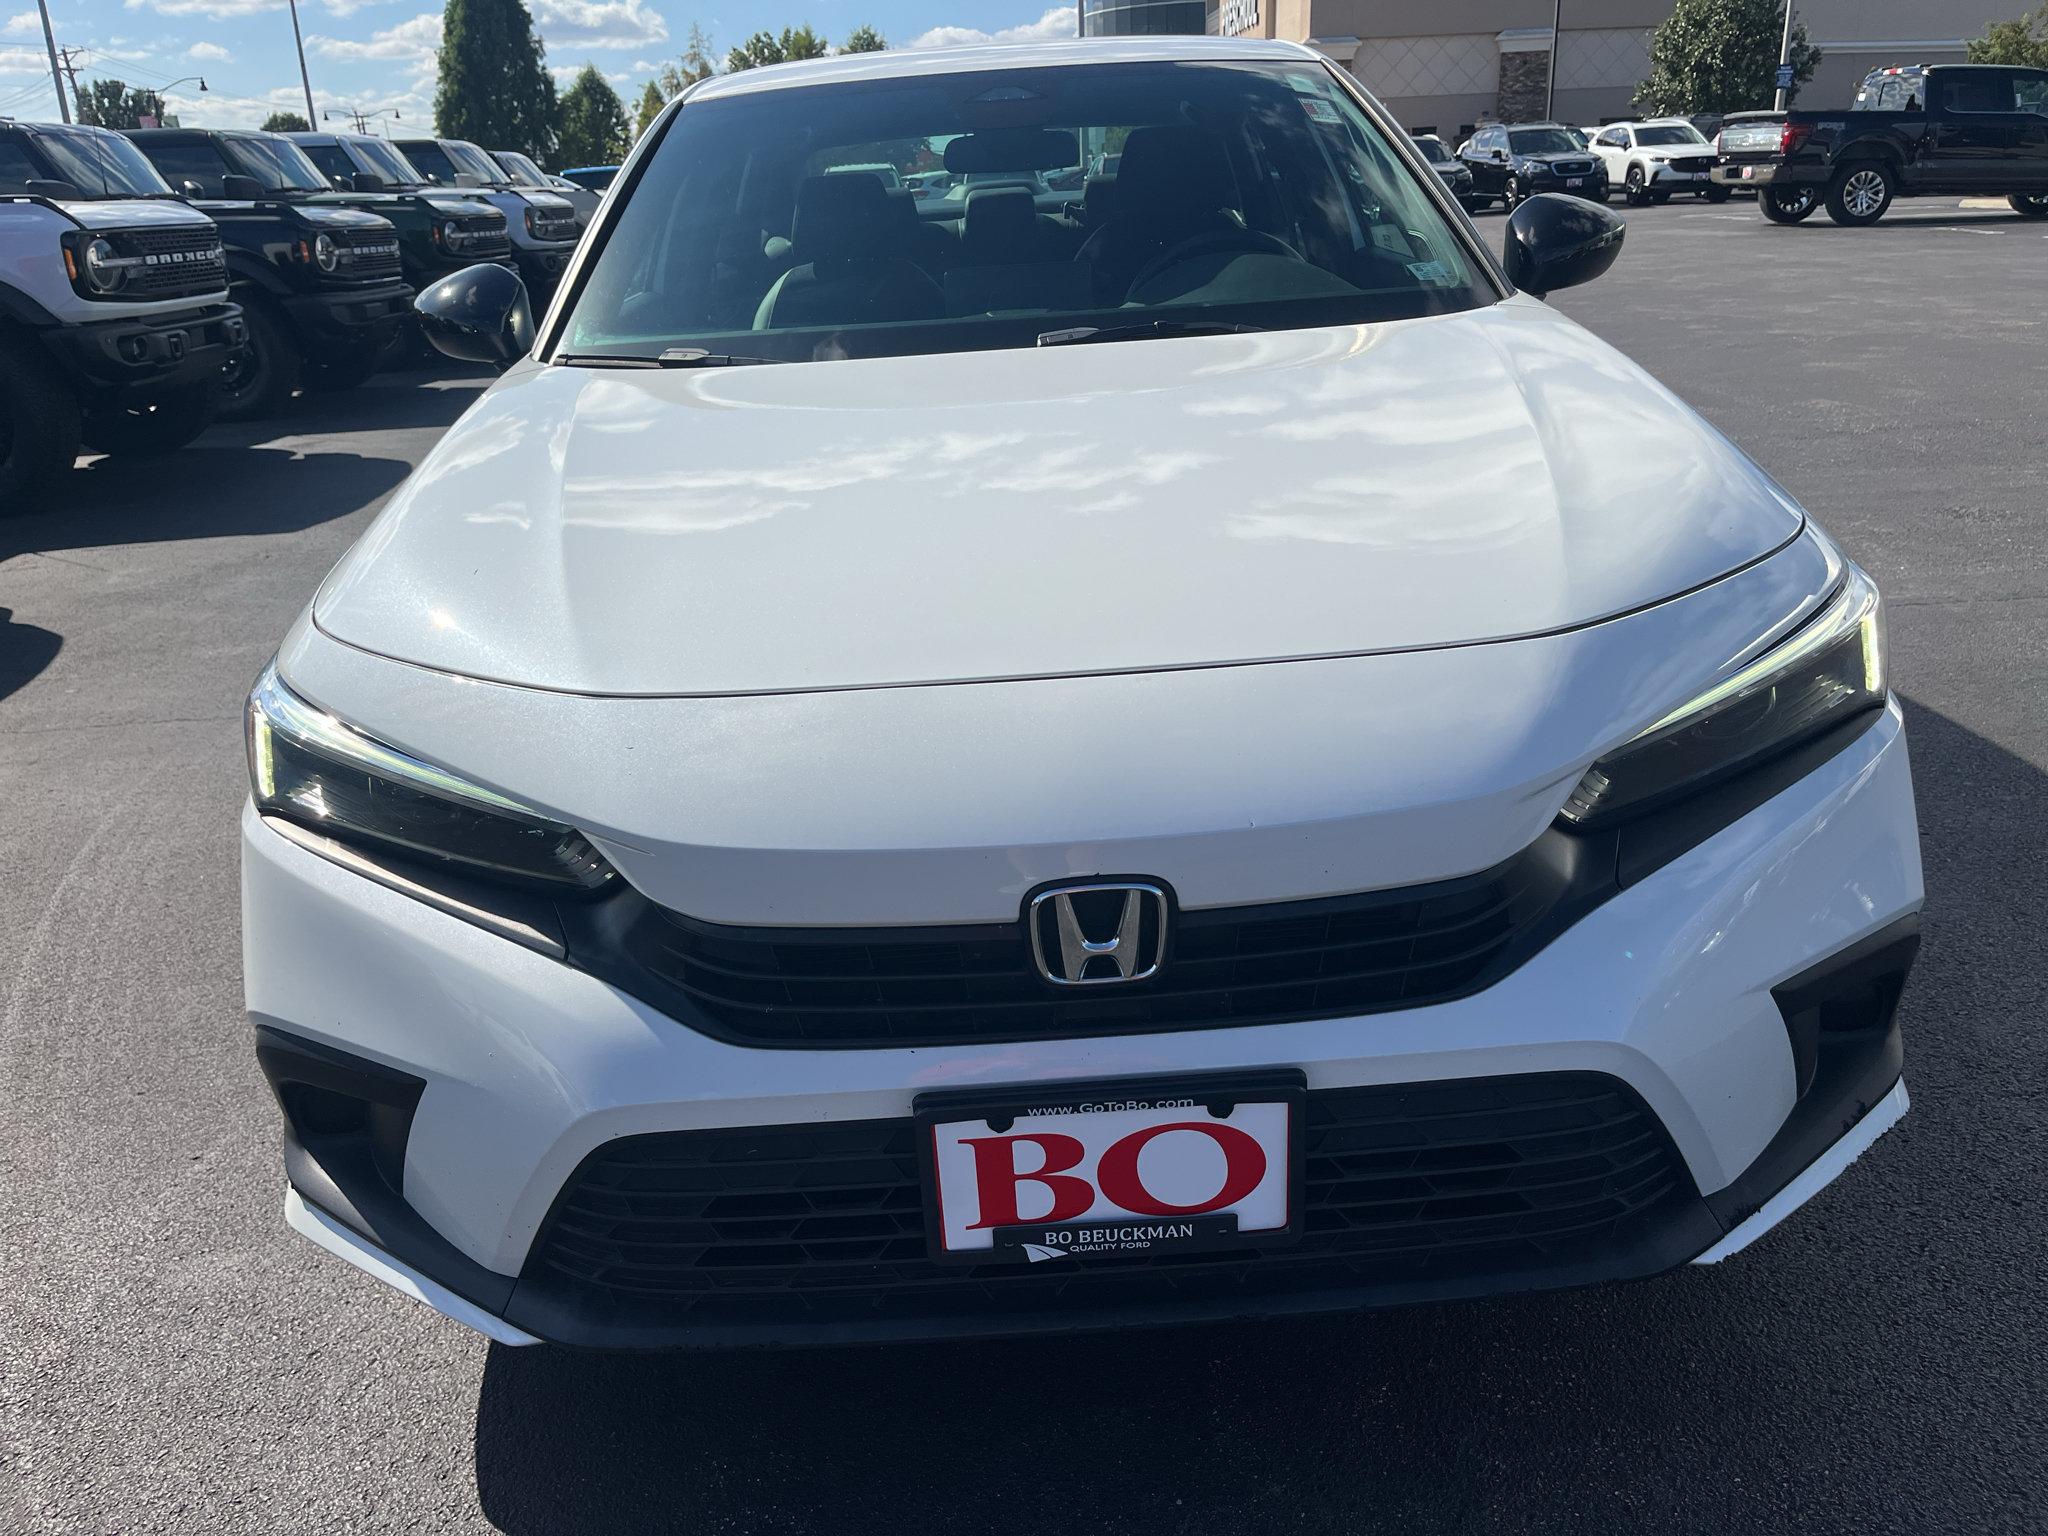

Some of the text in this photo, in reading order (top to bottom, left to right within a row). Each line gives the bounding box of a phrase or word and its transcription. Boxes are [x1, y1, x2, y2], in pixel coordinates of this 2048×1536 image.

[1027, 1098, 1194, 1117] www.GoToBo.com
[957, 1121, 1267, 1231] BO
[1045, 1224, 1193, 1245] BO BEUCKMAN
[1070, 1241, 1151, 1253] QUALITY FORD
